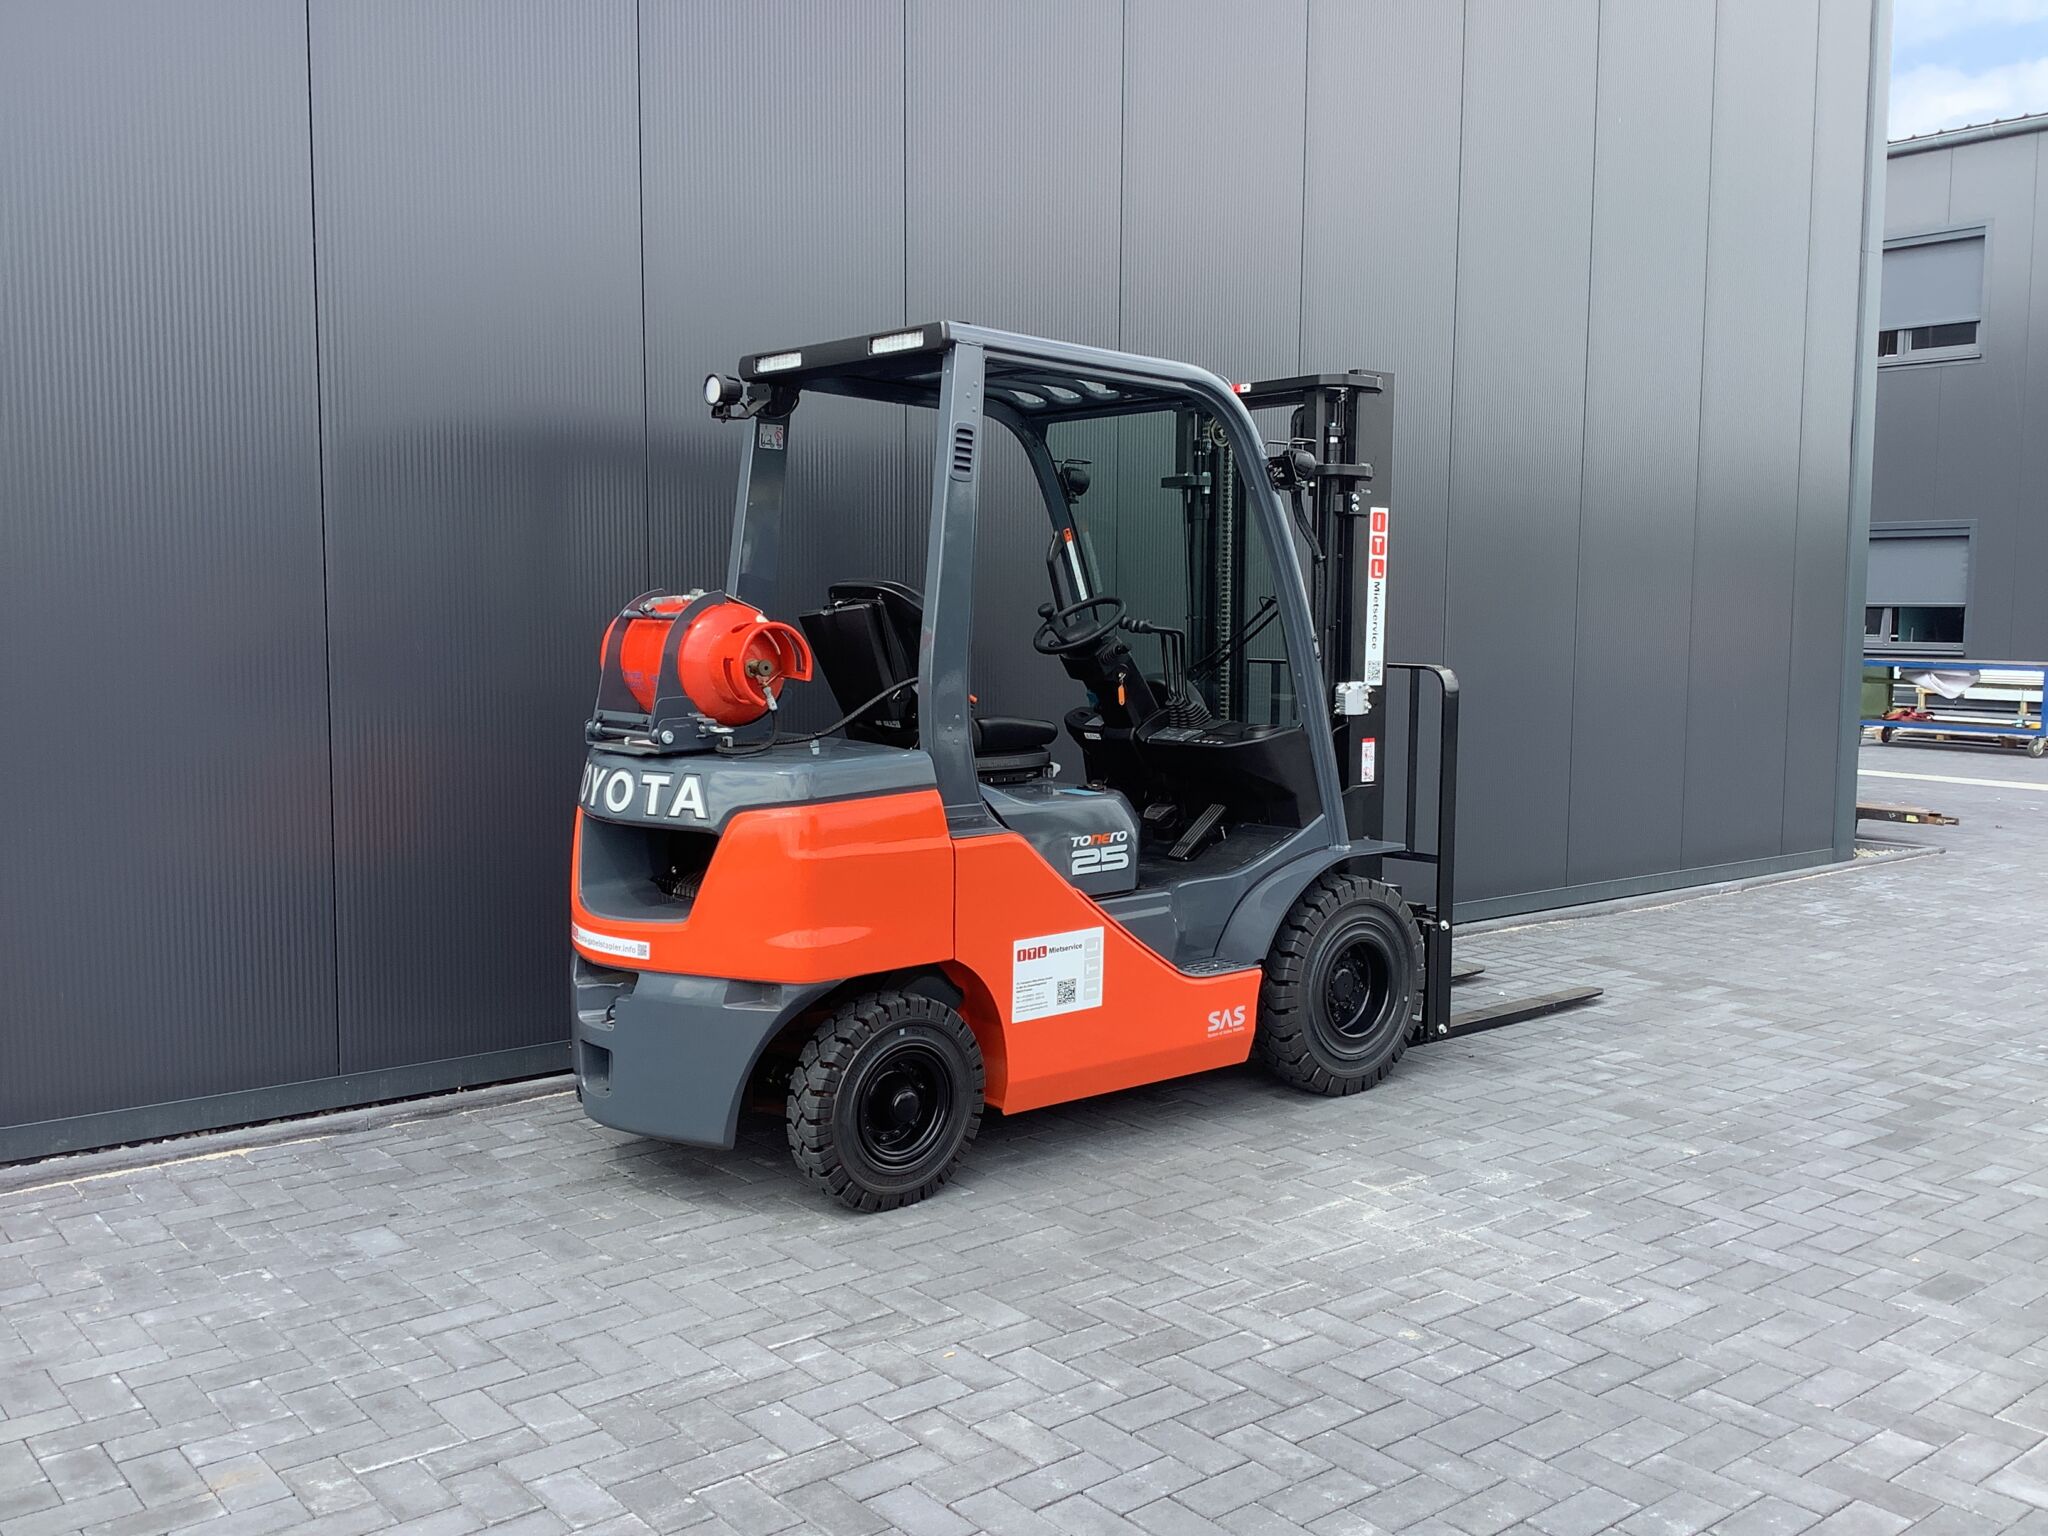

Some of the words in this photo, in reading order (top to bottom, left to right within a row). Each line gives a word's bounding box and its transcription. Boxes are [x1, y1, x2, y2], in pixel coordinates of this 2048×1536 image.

[1372, 513, 1385, 577] ITL
[1372, 581, 1381, 649] Mietservice
[580, 762, 707, 819] OYOTA
[1070, 830, 1128, 847] TONERO
[1071, 844, 1129, 875] 25
[1017, 946, 1047, 962] ITL
[1048, 943, 1083, 954] Mietservice
[1207, 1004, 1246, 1032] SAS
